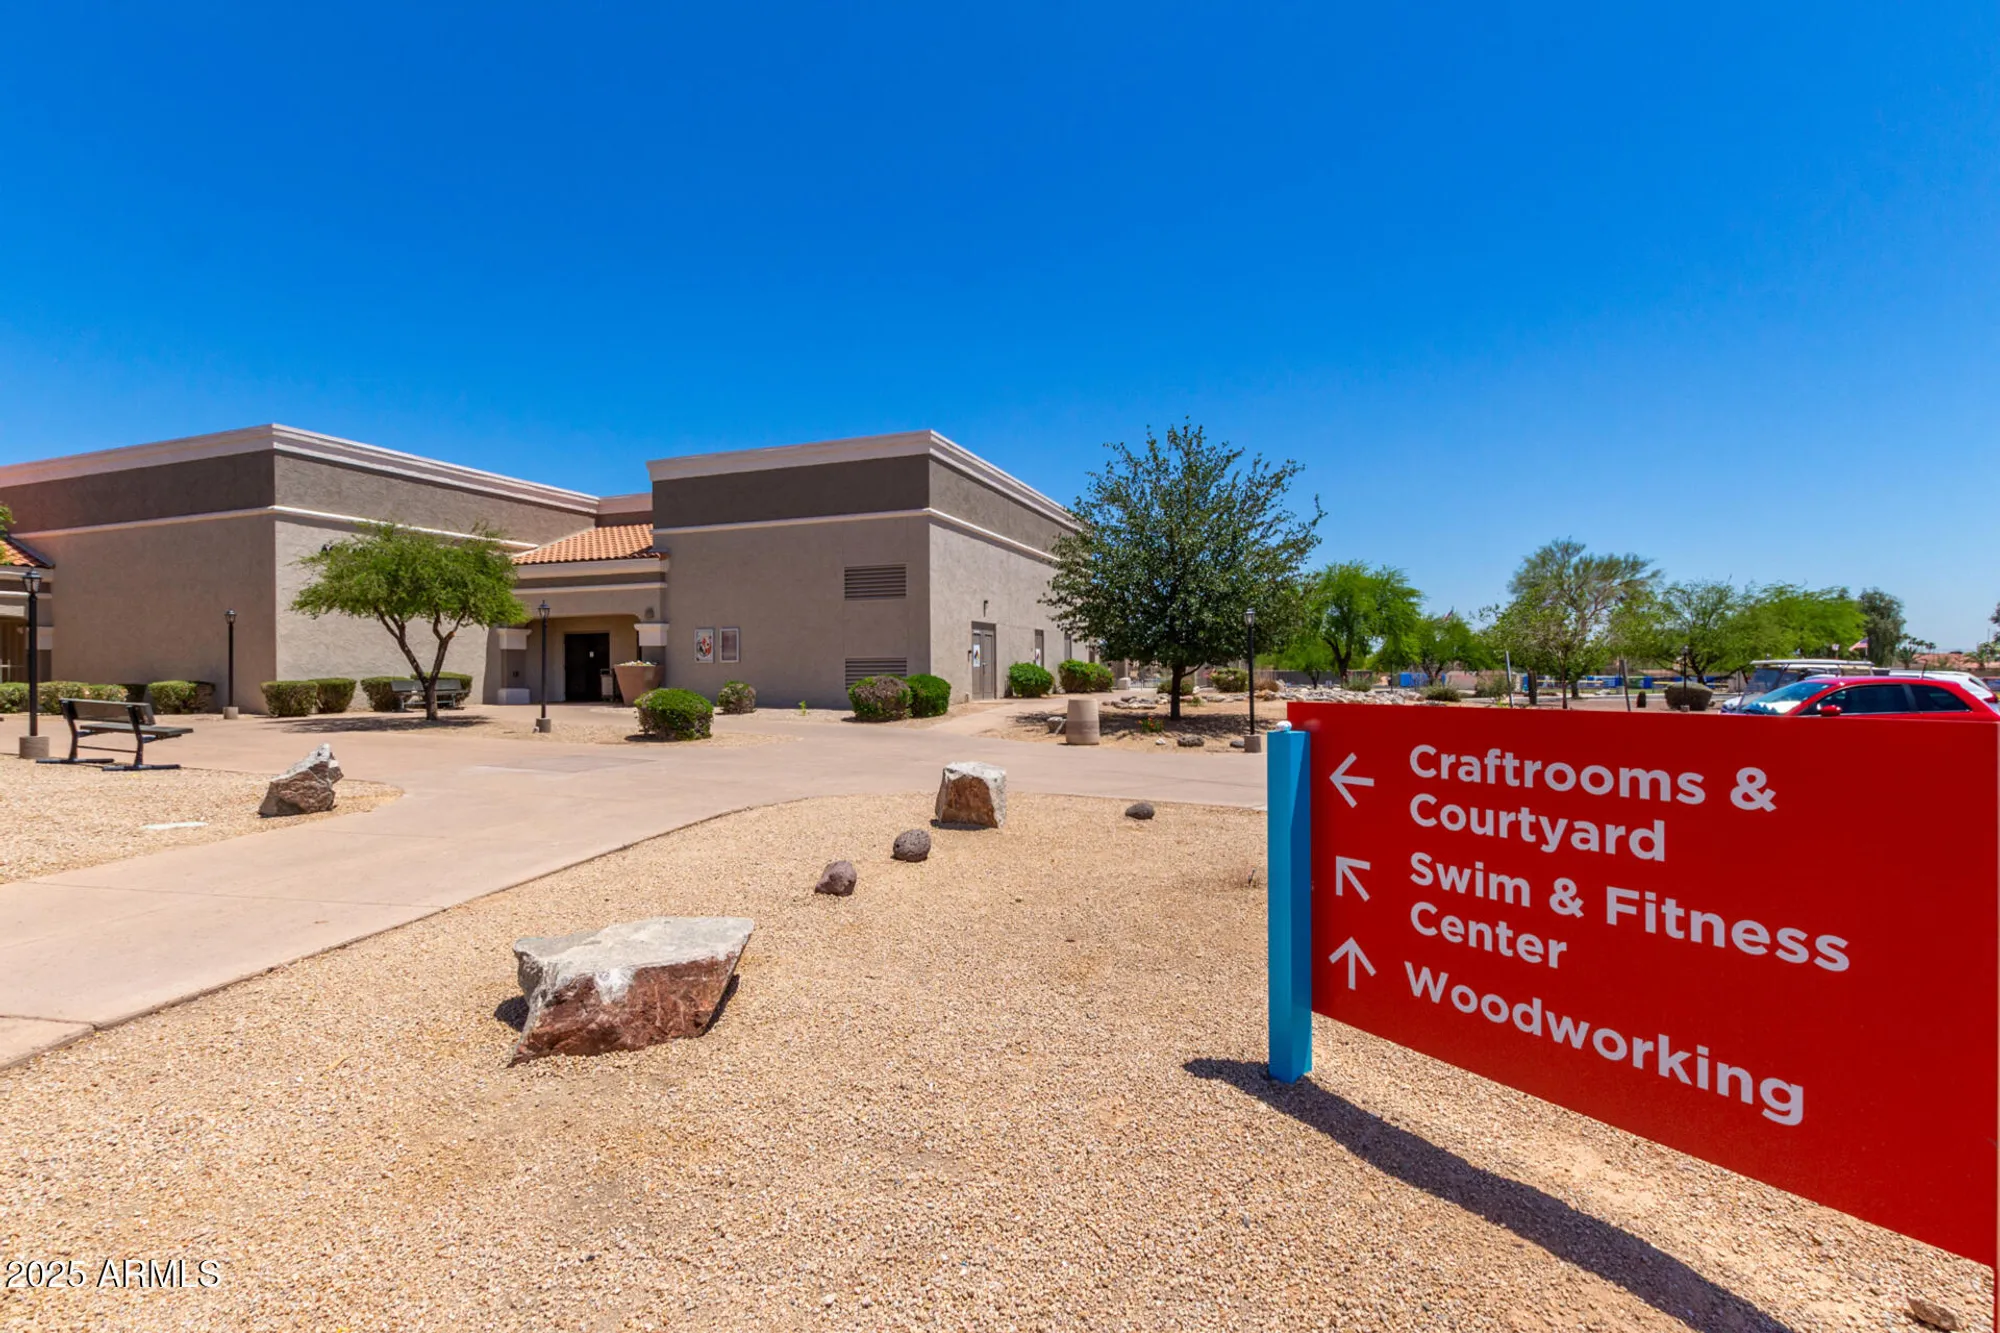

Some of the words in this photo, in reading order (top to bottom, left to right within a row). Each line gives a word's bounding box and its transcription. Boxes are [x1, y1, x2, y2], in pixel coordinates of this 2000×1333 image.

[1409, 745, 1705, 805] Craftrooms
[1730, 767, 1776, 812] &
[1409, 793, 1666, 863] Courtyard
[1410, 852, 1530, 908] Swim
[1549, 878, 1585, 919] &
[1606, 886, 1850, 975] Fitness
[1410, 902, 1567, 970] Center
[1404, 961, 1805, 1127] Woodworking
